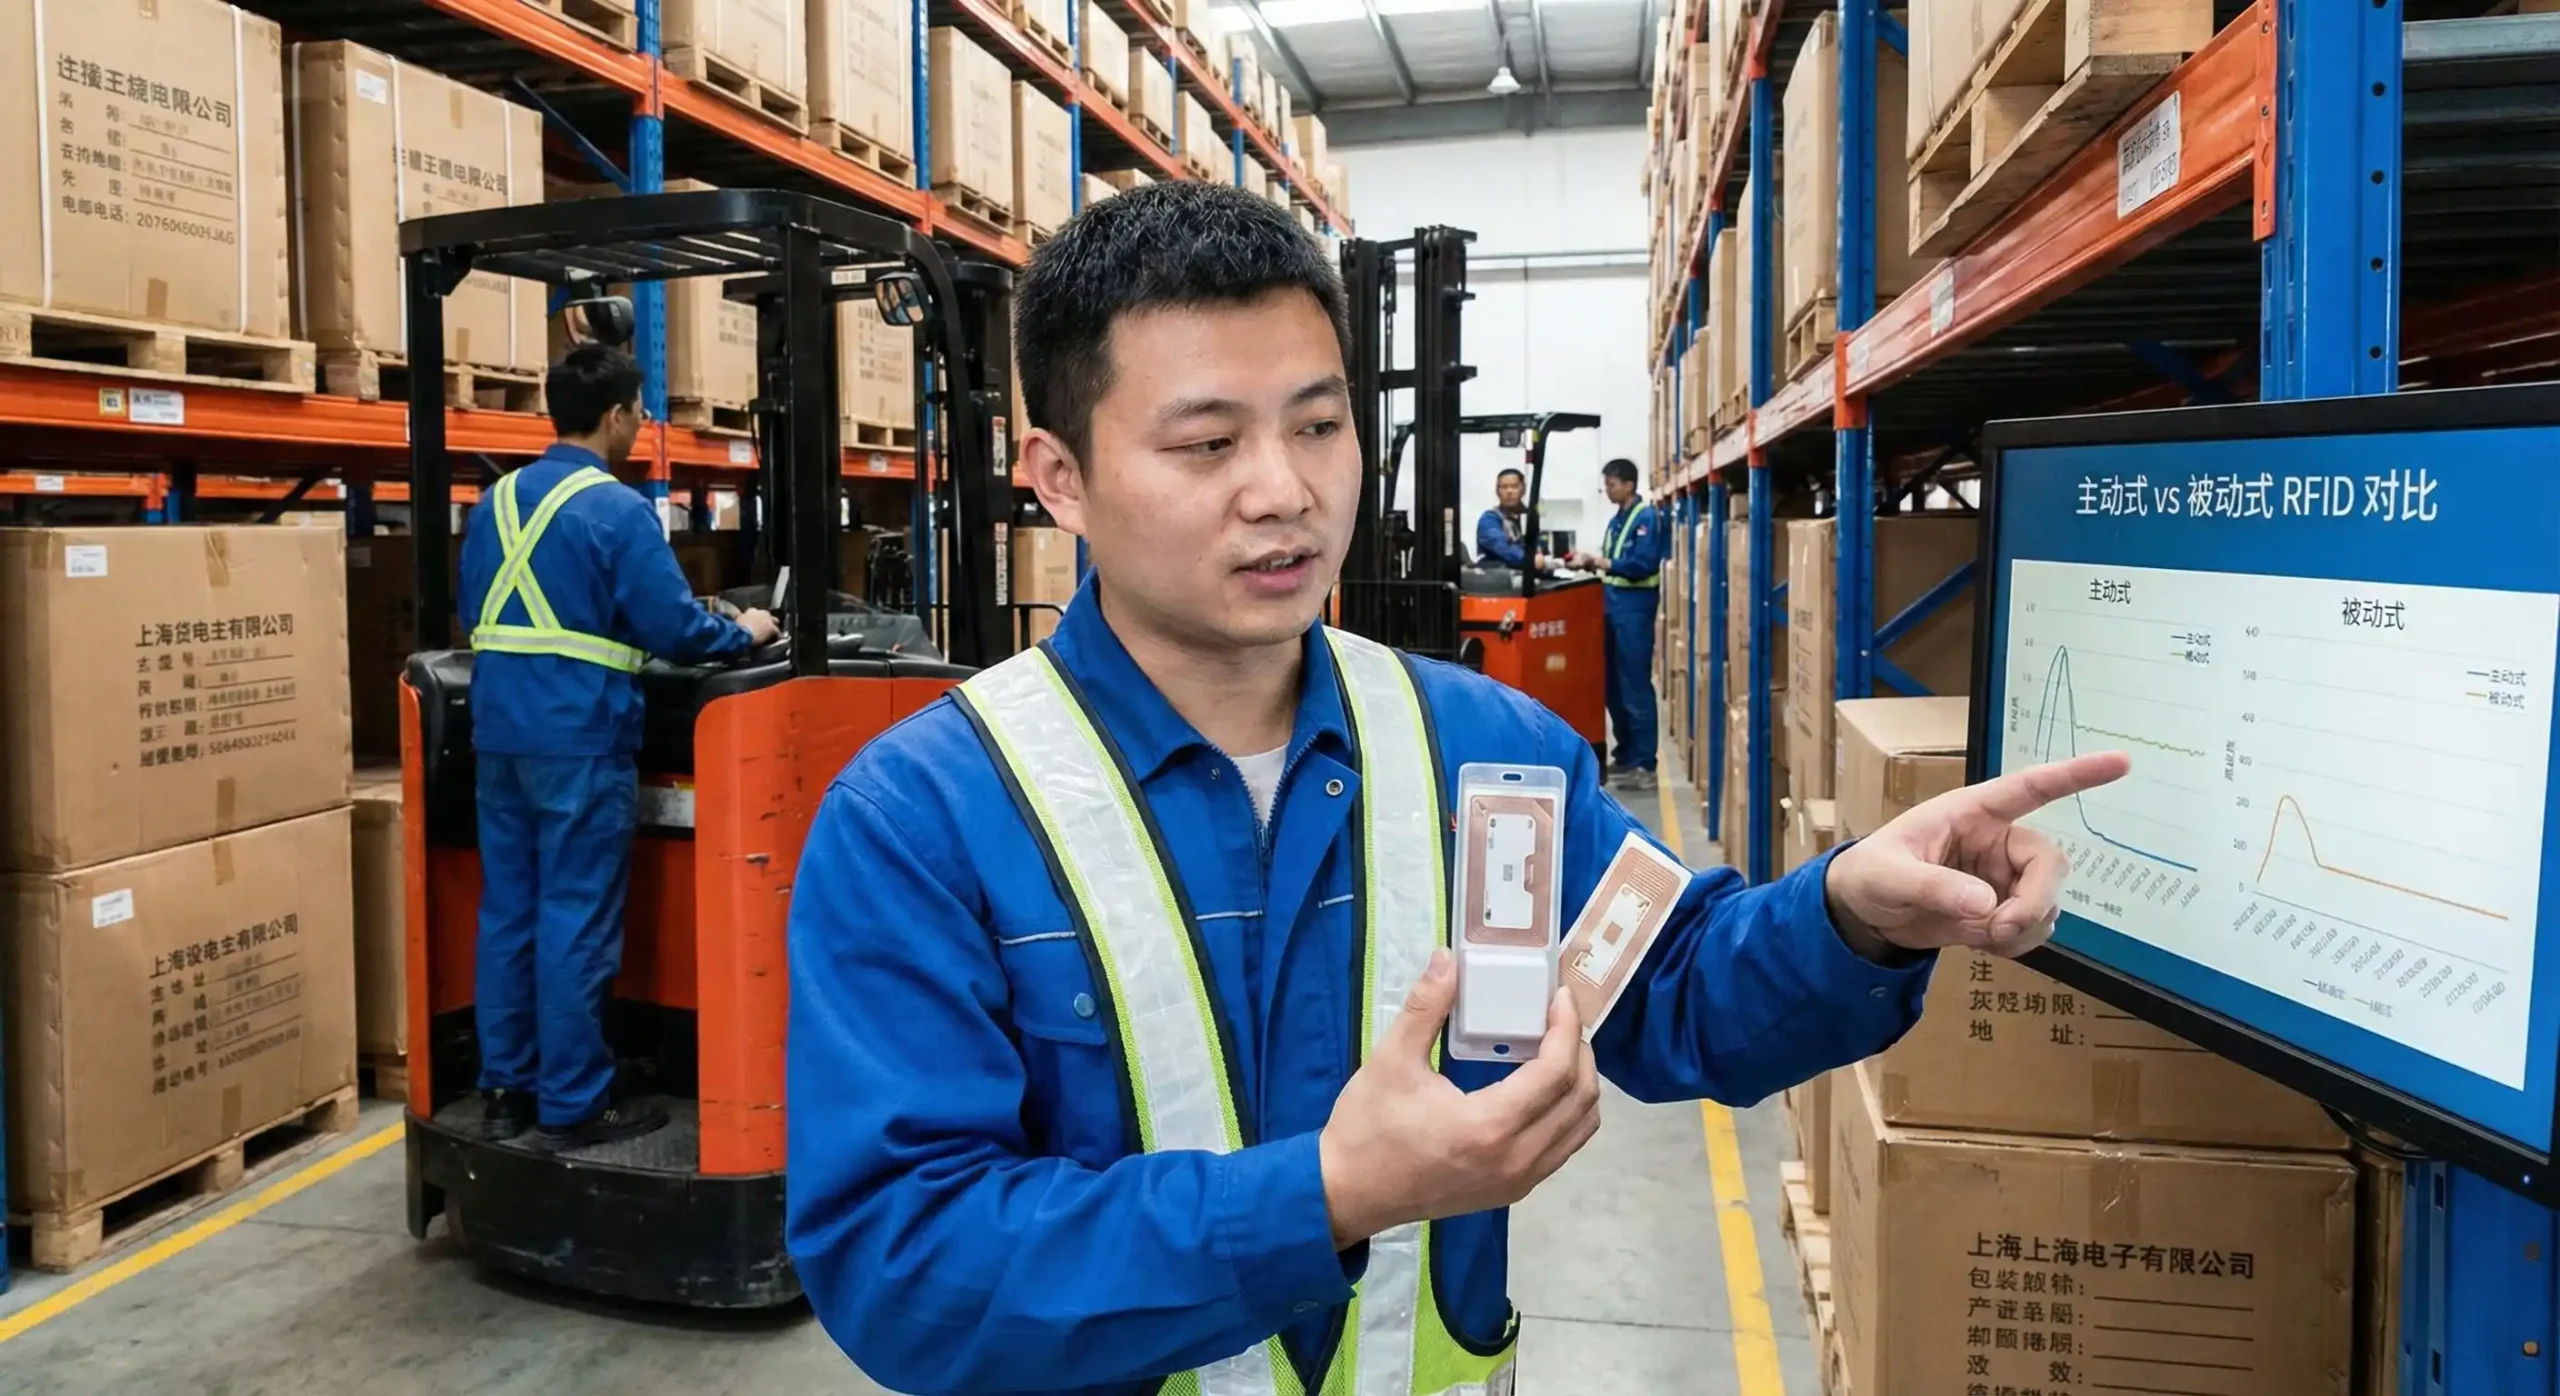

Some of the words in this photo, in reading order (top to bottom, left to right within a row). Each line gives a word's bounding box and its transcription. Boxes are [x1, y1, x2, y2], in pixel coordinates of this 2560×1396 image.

[2076, 474, 2148, 517] 主动式
[2154, 486, 2180, 514] vs
[2187, 472, 2274, 519] 被动式
[2283, 475, 2355, 517] RFID
[2362, 468, 2438, 522] 对比
[2089, 578, 2131, 604] 主动式
[2341, 596, 2405, 631] 被动式
[1967, 1231, 2255, 1280] 上海上海电子有限公司
